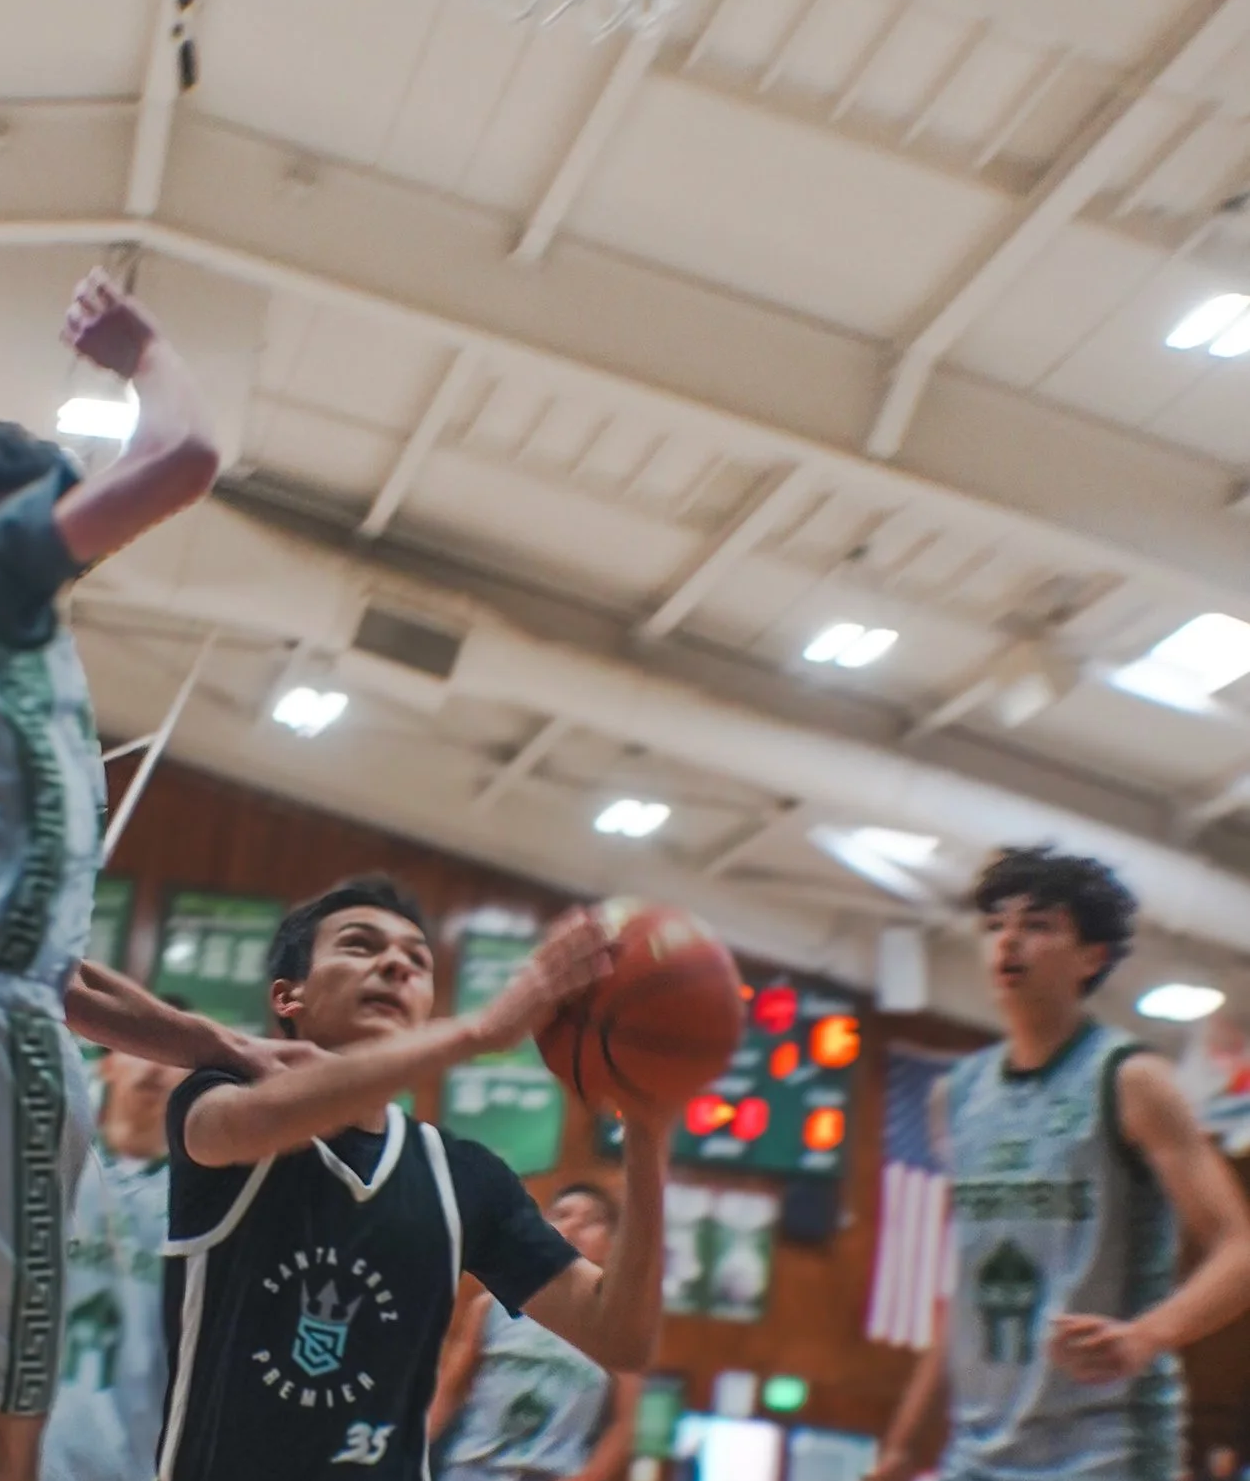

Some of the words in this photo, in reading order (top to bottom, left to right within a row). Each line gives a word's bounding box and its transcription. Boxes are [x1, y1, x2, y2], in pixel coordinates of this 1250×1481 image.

[262, 1246, 338, 1294] SANTA
[351, 1257, 399, 1322] CRUZ
[251, 1349, 376, 1409] PREMIER
[330, 1421, 398, 1466] 35
